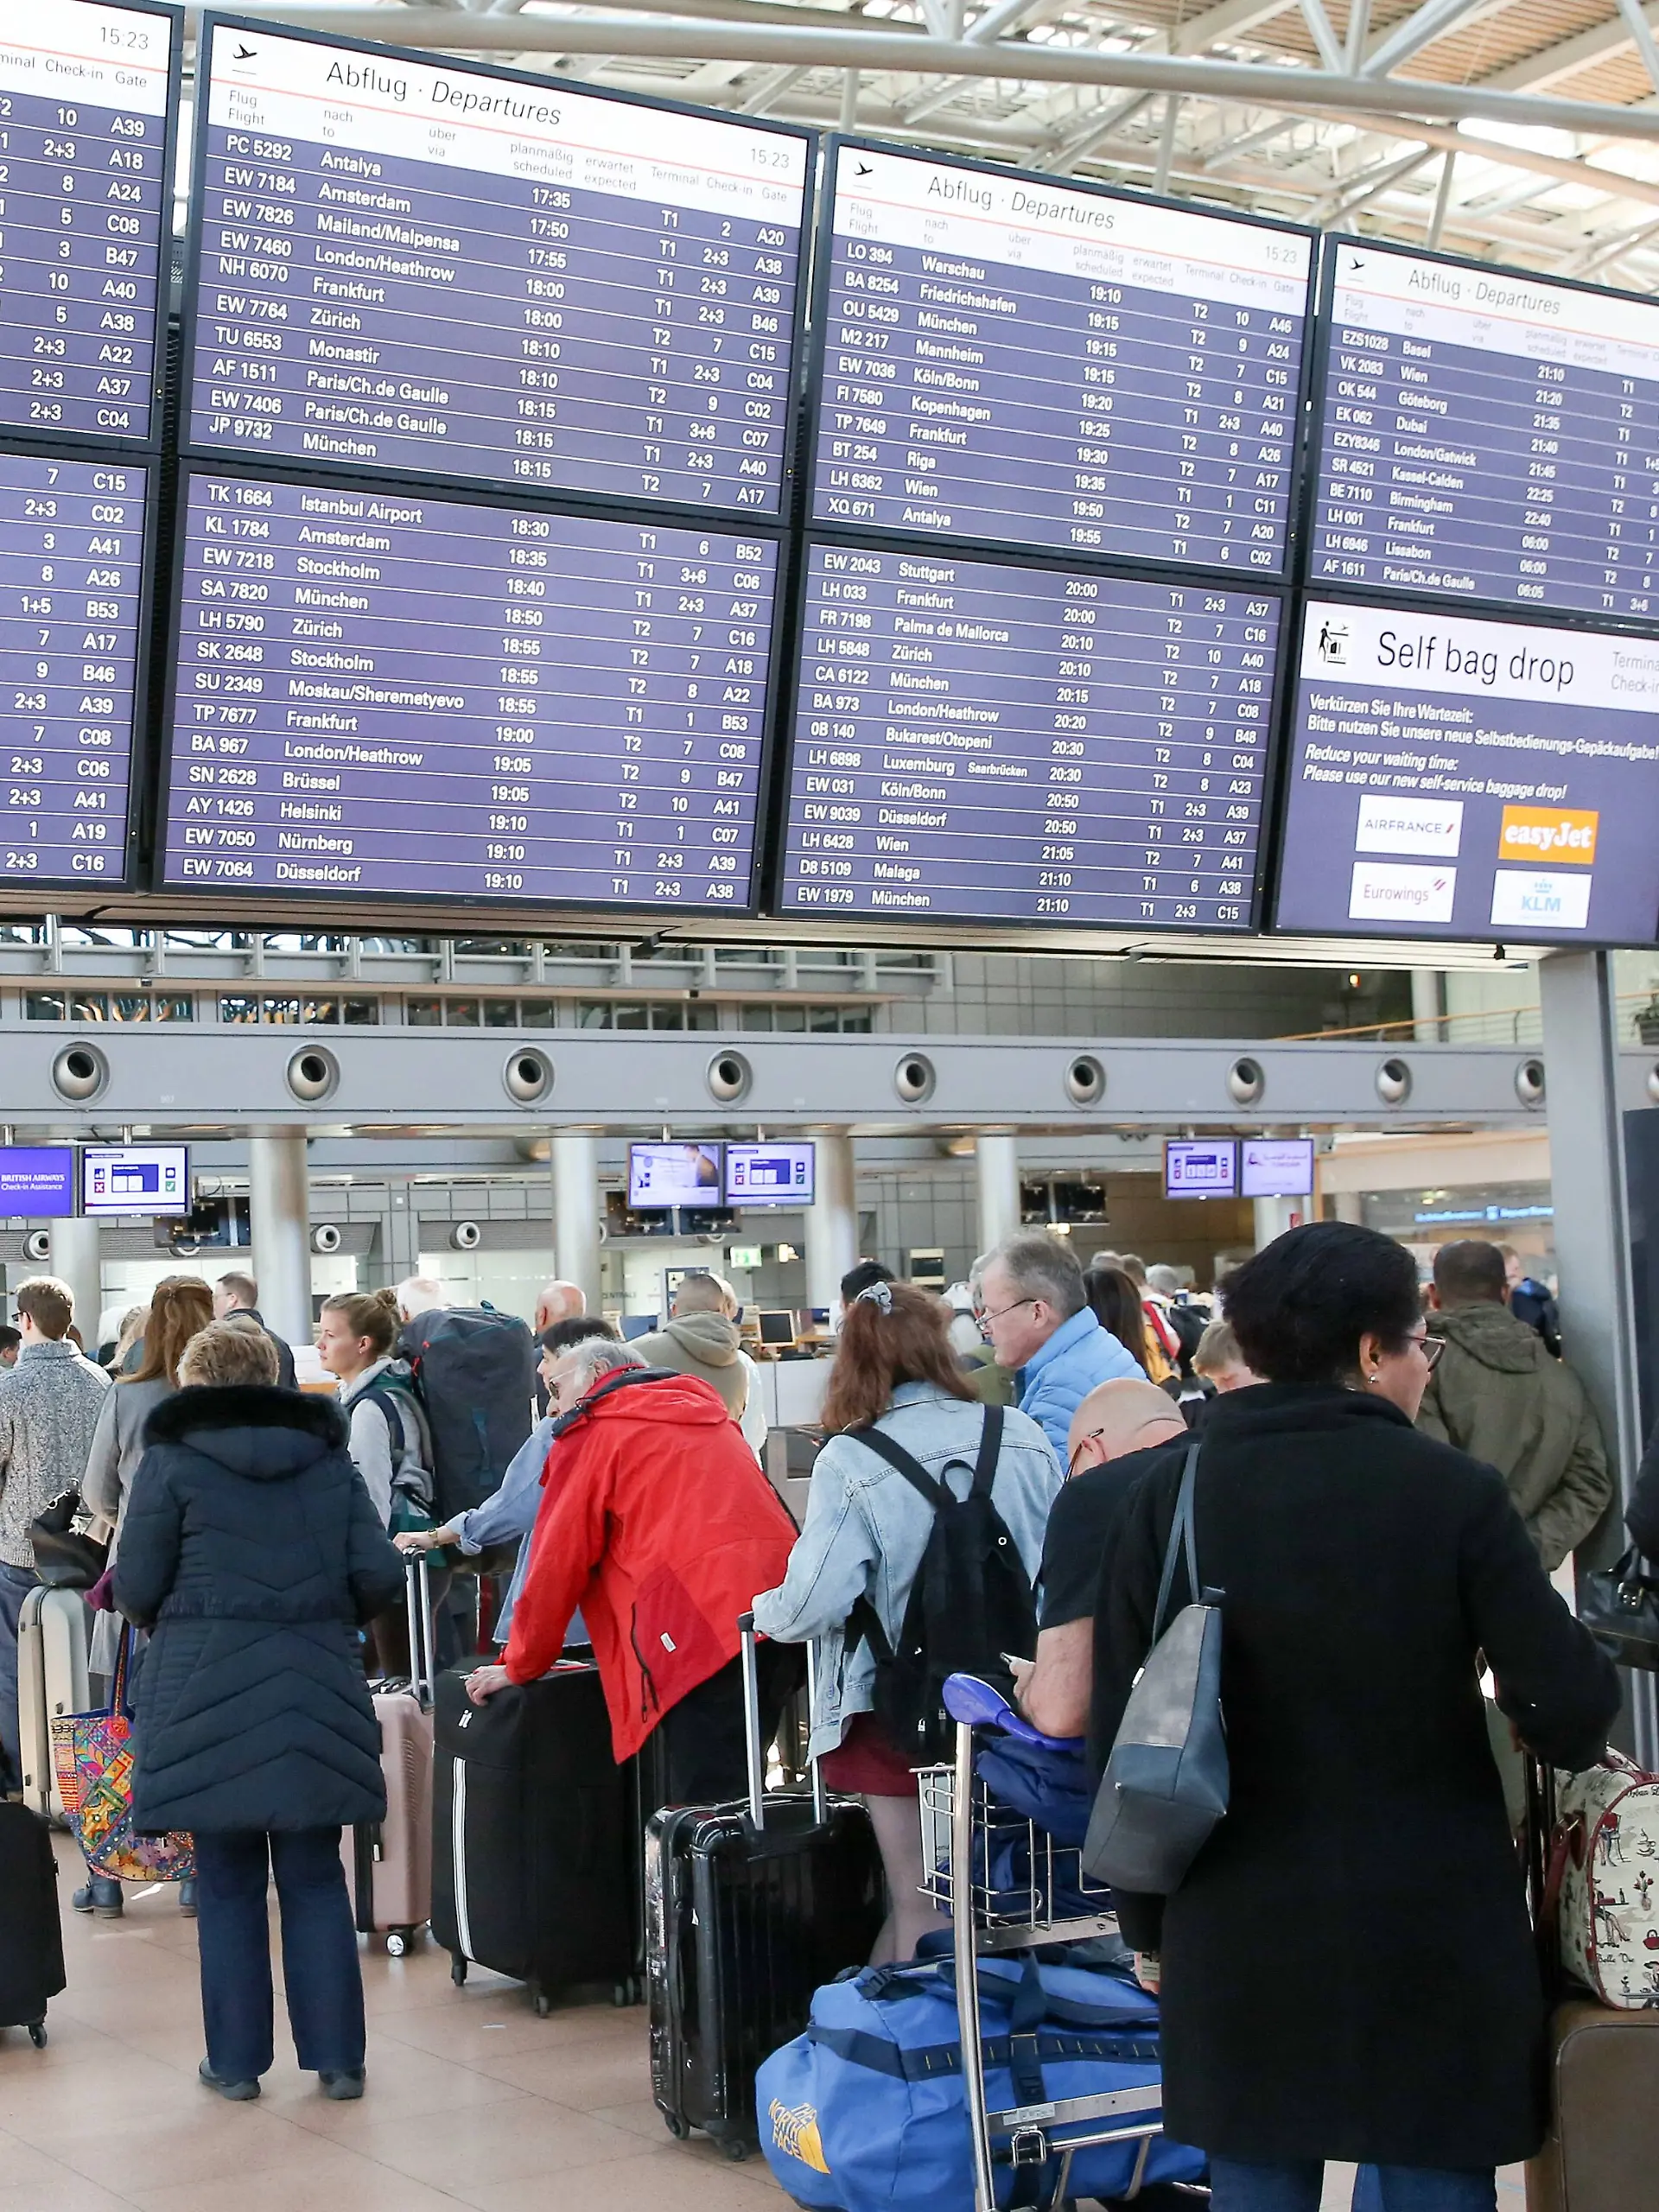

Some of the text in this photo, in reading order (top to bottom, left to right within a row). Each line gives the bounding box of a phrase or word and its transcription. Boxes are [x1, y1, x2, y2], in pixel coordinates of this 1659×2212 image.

[99, 26, 149, 51] 15:23
[44, 58, 148, 89] Check-in Gate
[326, 60, 563, 126] Abflug Departures
[110, 116, 145, 137] A39
[227, 107, 266, 127] Flight
[512, 159, 573, 181] scheduled
[583, 172, 638, 192] expected
[229, 90, 258, 110] Flug
[323, 108, 353, 124] nach
[585, 156, 634, 175] erwartet
[651, 166, 700, 188] Terminal
[705, 176, 754, 197] Check-in
[760, 187, 788, 202] Gate
[108, 149, 143, 169] A18
[749, 147, 791, 169] 15:23
[106, 181, 142, 202] A24
[226, 134, 785, 246] PC 5292 Antalya 17:35 T1 2 A20
[927, 175, 1116, 231] Abflug Departures
[106, 213, 140, 234] C08
[224, 165, 782, 275] EW 7184 Amsterdam 17:50 T1 2+3 A38
[848, 219, 879, 235] Flight
[316, 213, 460, 252] Mailand/Malpensa
[849, 202, 874, 219] Flug
[1185, 264, 1225, 283] Terminal
[1273, 281, 1295, 295] Gate
[1264, 245, 1298, 264] 15:23
[315, 244, 455, 282] London/Heathrow
[921, 254, 985, 280] Warschau
[313, 276, 385, 302] Frankfurt
[919, 283, 1017, 314] Friedrichshafen
[1408, 269, 1561, 316] Abflug Departures
[309, 307, 360, 330] Zürich
[917, 310, 977, 335] München
[308, 338, 380, 364] Monastir
[915, 338, 984, 365] Mannheim
[1402, 340, 1432, 359] Basel
[912, 366, 980, 391] Köln/Bonn
[1400, 365, 1428, 384] Wien
[306, 369, 448, 404] Paris/Ch.de Gaulle
[911, 394, 991, 422] Kopenhagen
[1397, 391, 1449, 415] Göteborg
[304, 401, 447, 435] Paris/Ch.de Gaulle
[1395, 415, 1427, 434] Dubai
[302, 432, 377, 457] München
[908, 423, 967, 446] Frankfurt
[906, 450, 936, 471] Riga
[92, 472, 126, 491] C15
[904, 478, 938, 498] Wien
[301, 493, 423, 524] Istanbul Airport
[1389, 490, 1453, 513] Birmingham
[91, 504, 124, 524] C02
[901, 505, 951, 529] Antalya
[1387, 515, 1435, 536] Frankfurt
[86, 536, 120, 556] A41
[297, 525, 390, 550] Amsterdam
[1384, 540, 1432, 560] Lissabon
[296, 556, 380, 581] Stockholm
[898, 561, 955, 583] Stuttgart
[1382, 565, 1475, 590] Paris/Ch.de Gaulle
[294, 587, 368, 610] München
[896, 588, 954, 609] Frankfurt
[291, 617, 343, 639] Zürich
[893, 616, 1009, 642] Palma de Mallorca
[289, 648, 374, 671] Stockholm
[891, 644, 932, 663] Zürich
[1378, 631, 1573, 691] Self bag drop
[889, 671, 949, 691] München
[288, 679, 464, 710] Moskau/Sheremetyevo
[286, 709, 358, 731] Frankfurt
[887, 699, 1000, 722] London/Heathrow
[1310, 694, 1472, 723] Verkürzen Sie Ihre Wartezeit:
[885, 726, 993, 751] Bukarest/Otopeni
[1307, 715, 1336, 733] Bitte
[1338, 721, 1377, 737] nutzen
[1381, 722, 1400, 738] Sie
[1402, 727, 1442, 742] unsere
[1445, 729, 1472, 745] neue
[284, 740, 423, 766] London/Heathrow
[1305, 744, 1459, 771] Reduce your waiting time:
[882, 753, 955, 777] Luxemburg
[282, 771, 340, 791] Brüssel
[880, 780, 946, 800] Köln/Bonn
[1303, 765, 1567, 801] Please use our new self-service baggage drop!
[280, 801, 342, 821] Helsinki
[878, 808, 947, 827] Düsseldorf
[277, 831, 353, 855] Nürnberg
[875, 835, 909, 852] Wien
[1505, 823, 1592, 850] easyJet
[71, 853, 105, 871] C16
[276, 862, 361, 881] Düsseldorf
[873, 862, 920, 882] Malaga
[871, 889, 930, 906] München
[1363, 884, 1429, 905] Eurowings
[1521, 895, 1560, 912] KLM
[2, 1173, 65, 1182] BRITISH AIRWAYS
[458, 1709, 472, 1728] it
[768, 2098, 805, 2144] NORTH
[791, 2103, 817, 2125] THE
[772, 2126, 804, 2160] FACE
